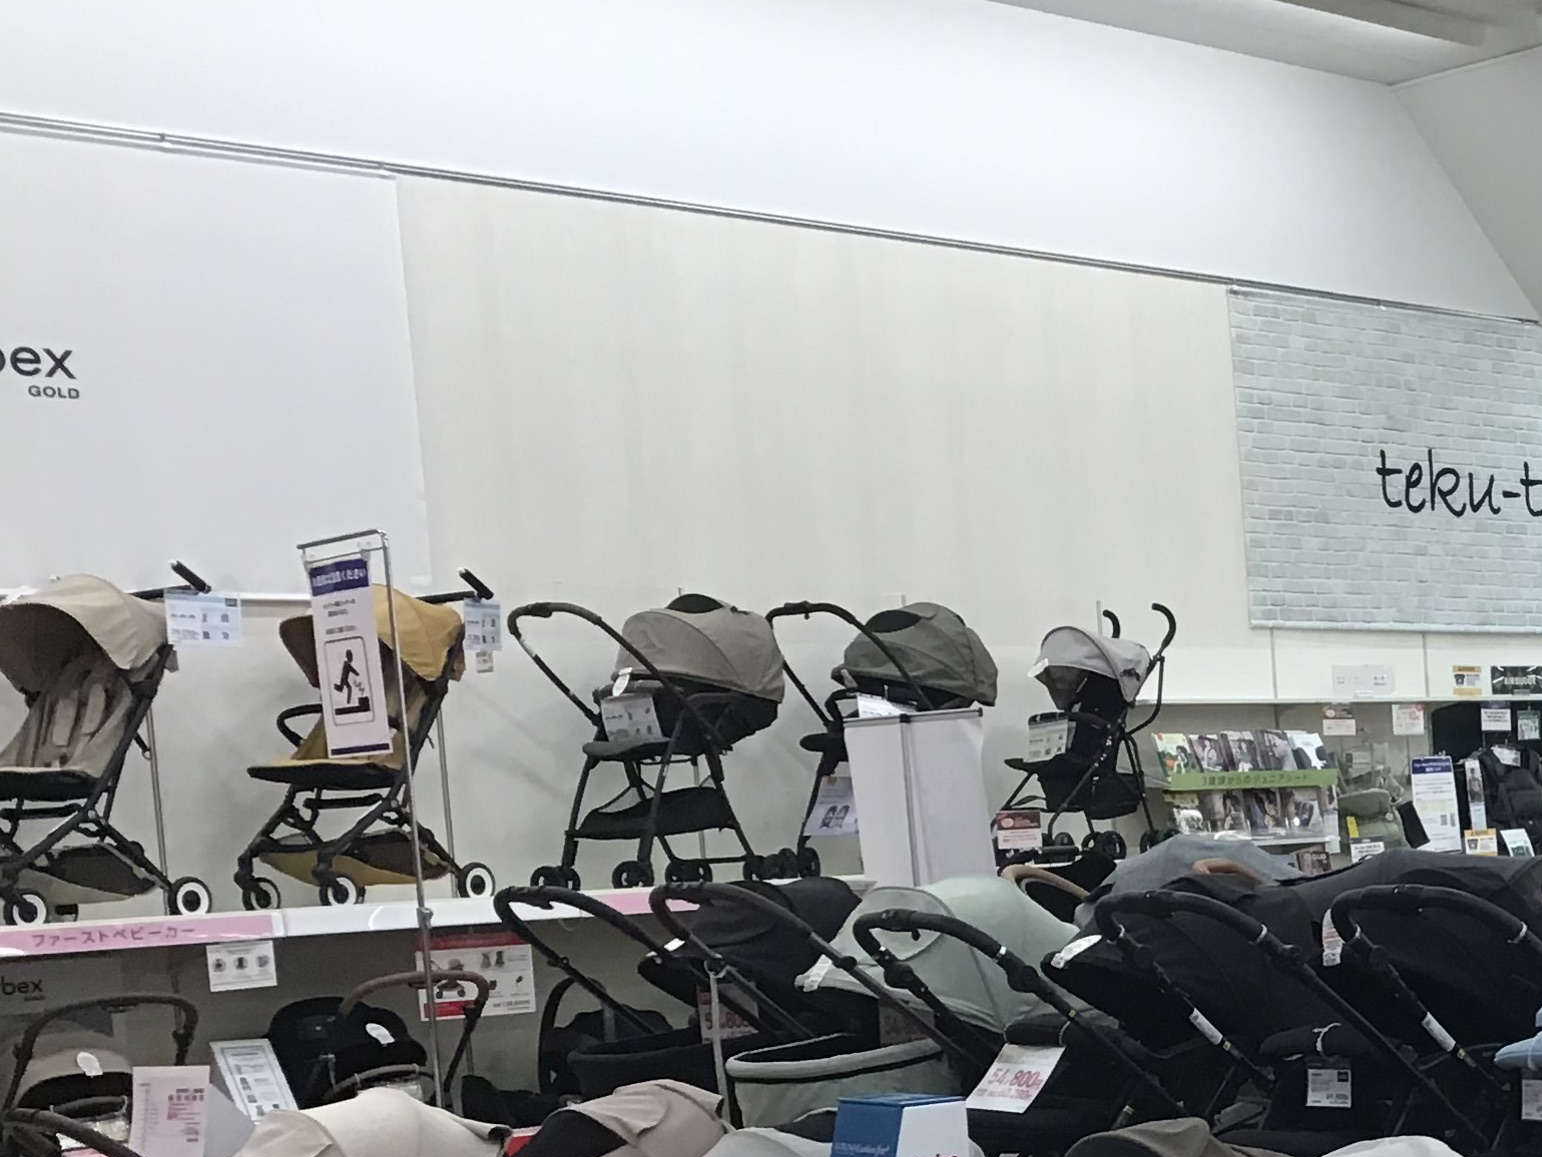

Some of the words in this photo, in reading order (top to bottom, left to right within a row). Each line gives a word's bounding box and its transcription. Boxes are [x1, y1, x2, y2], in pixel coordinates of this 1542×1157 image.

[0, 346, 77, 380] ex
[28, 385, 80, 399] GOLD
[32, 927, 195, 948] ファーストベビーカー
